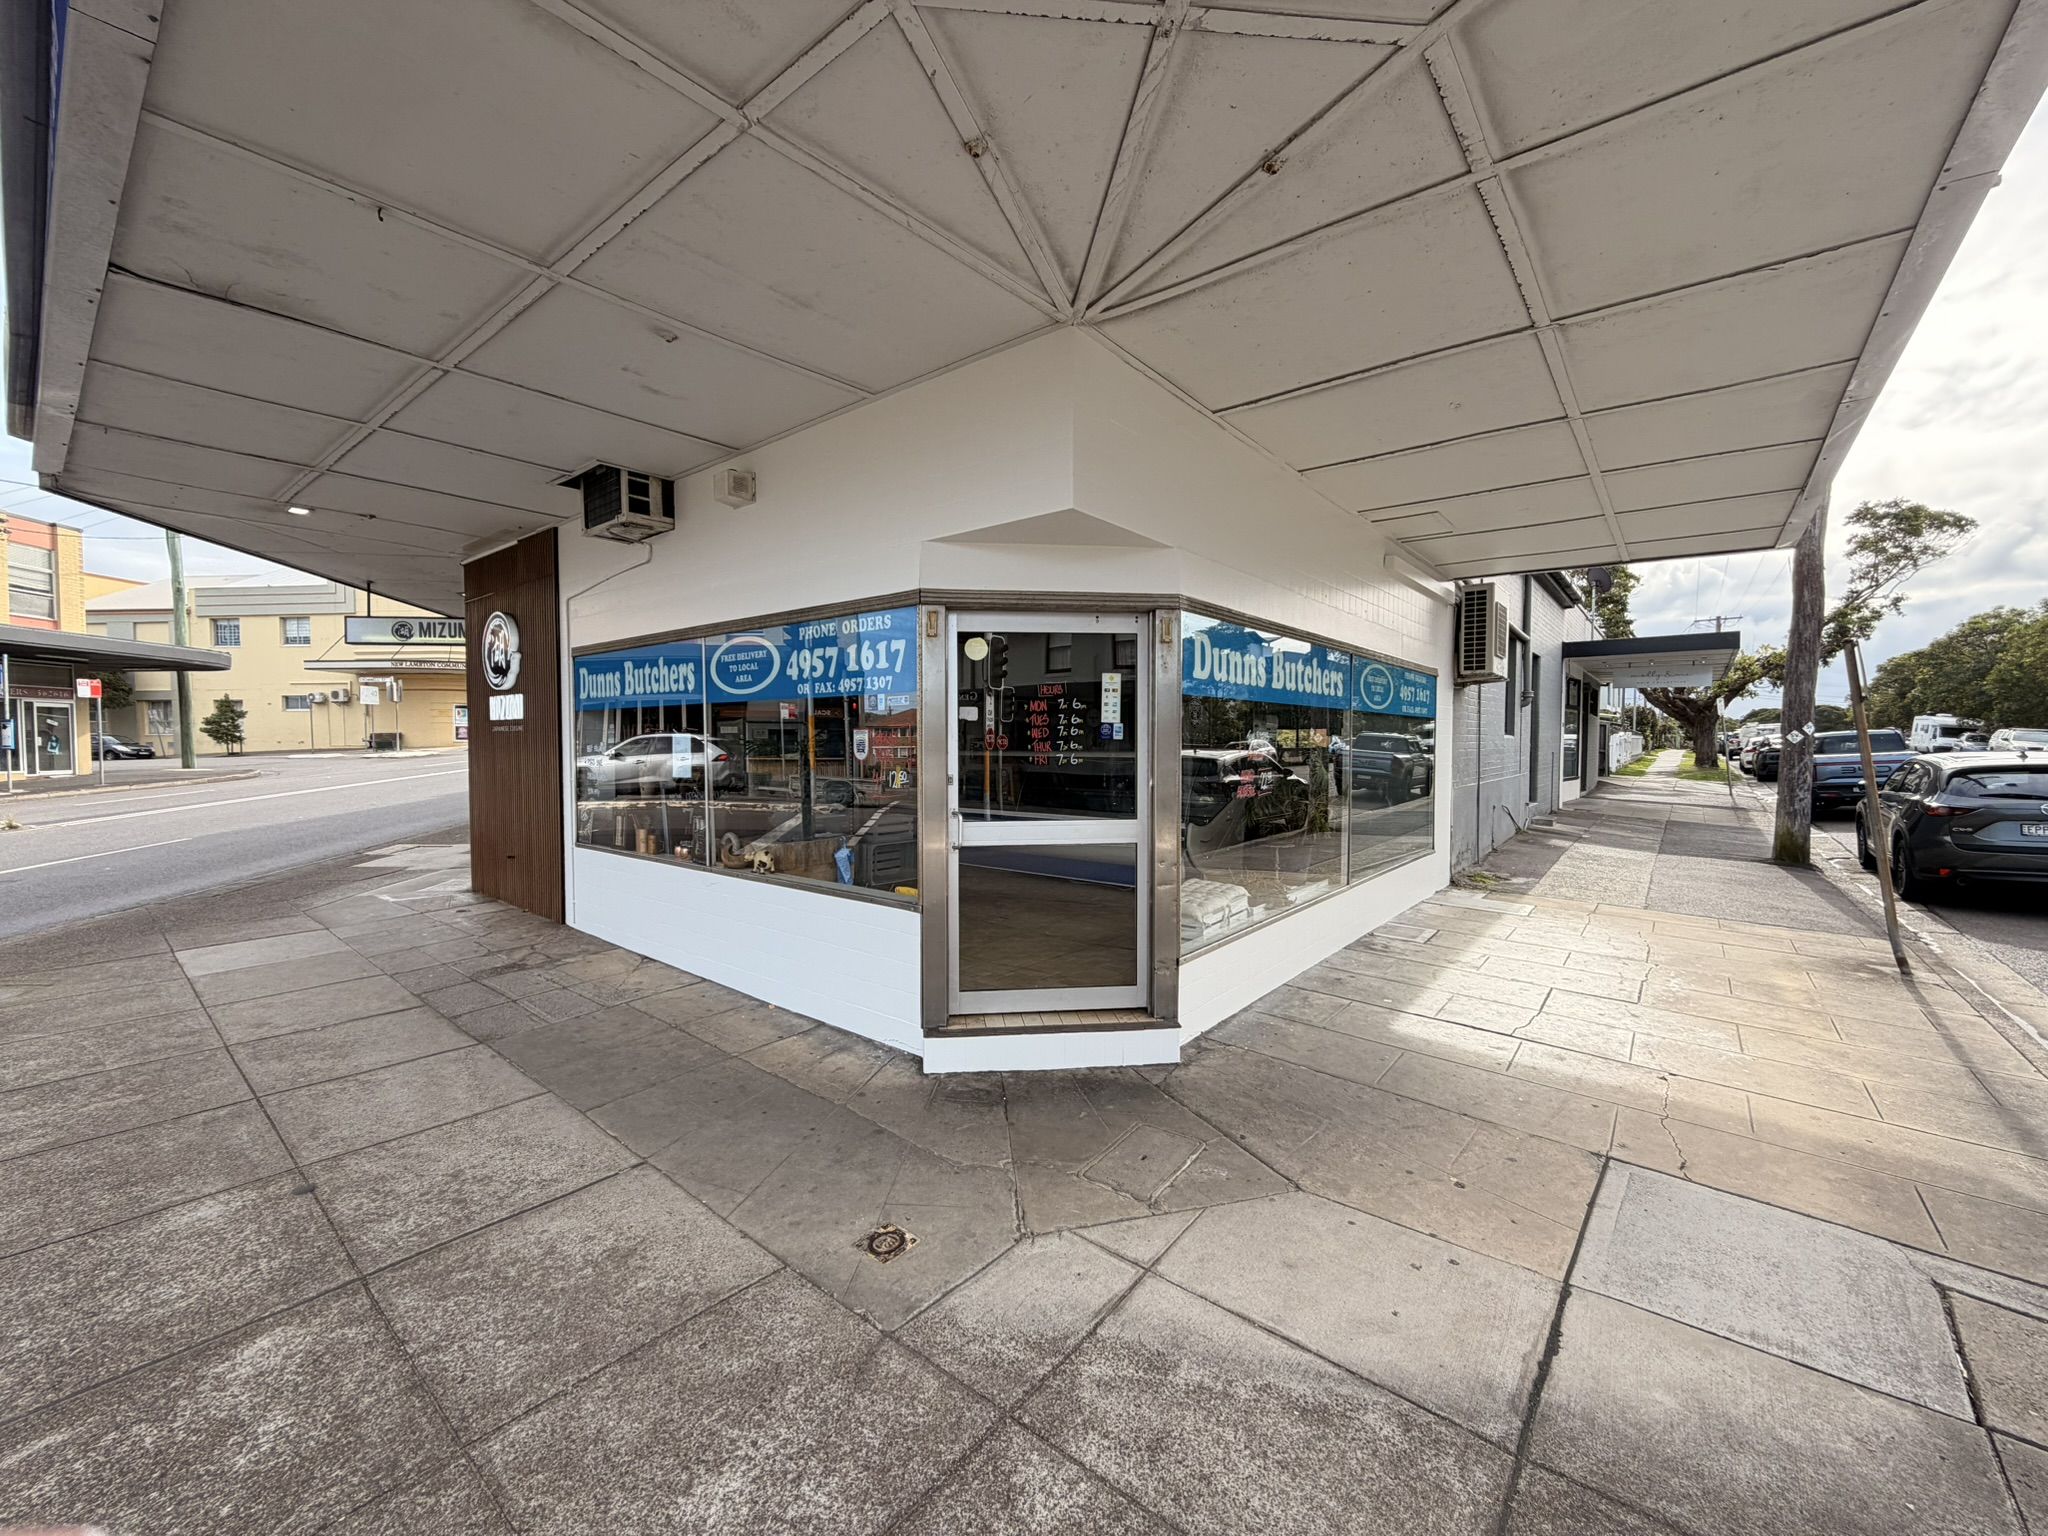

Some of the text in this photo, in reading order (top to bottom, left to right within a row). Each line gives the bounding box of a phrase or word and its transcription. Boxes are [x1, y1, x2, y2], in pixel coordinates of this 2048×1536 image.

[799, 614, 892, 640] PHONE ORDERS
[720, 649, 768, 663] FREE DELIVERY
[786, 639, 906, 681] 4957 1617
[729, 662, 759, 673] TO LOCAL
[1193, 632, 1344, 697] Dunns Butchers
[579, 656, 696, 699] Dunns Butchers
[735, 674, 752, 683] AREA
[797, 676, 893, 694] OR FAX: 4957 1307
[1040, 684, 1063, 695] HOURS
[1029, 701, 1048, 712] MON
[1029, 713, 1049, 726] TUES
[1031, 727, 1049, 739] WED
[1032, 740, 1052, 752] THUR
[1034, 754, 1048, 765] FRI
